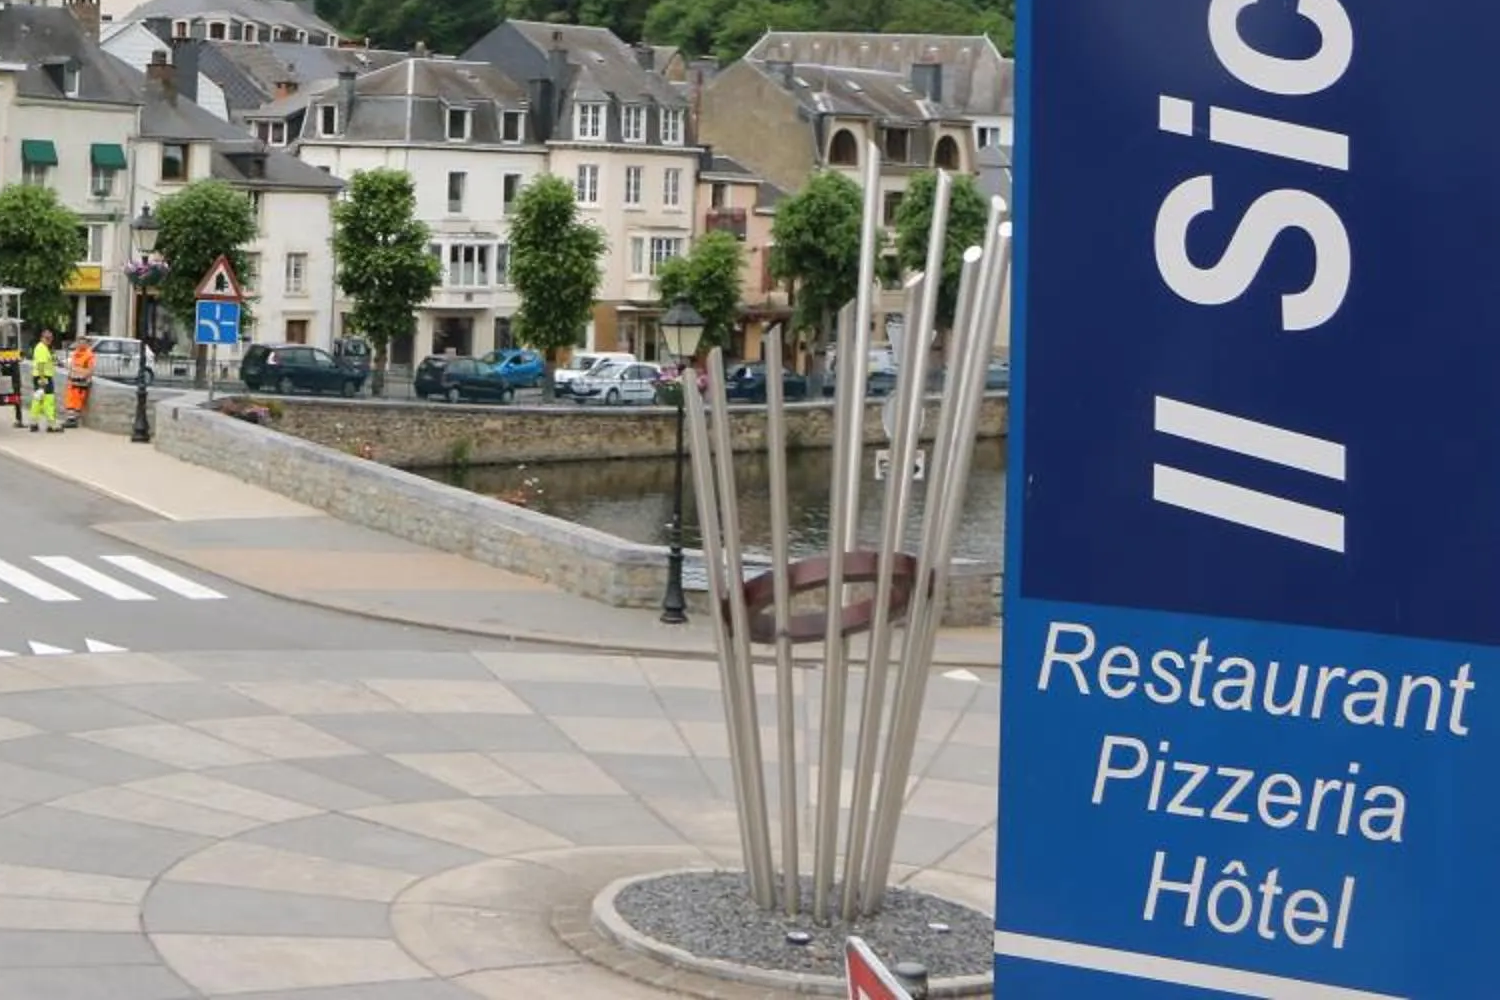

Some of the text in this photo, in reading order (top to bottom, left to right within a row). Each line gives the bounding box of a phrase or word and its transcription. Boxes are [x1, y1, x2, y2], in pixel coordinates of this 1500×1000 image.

[1036, 621, 1476, 737] Restaurant
[1091, 735, 1407, 843] Pizzeria
[1143, 851, 1356, 950] Hôtel
